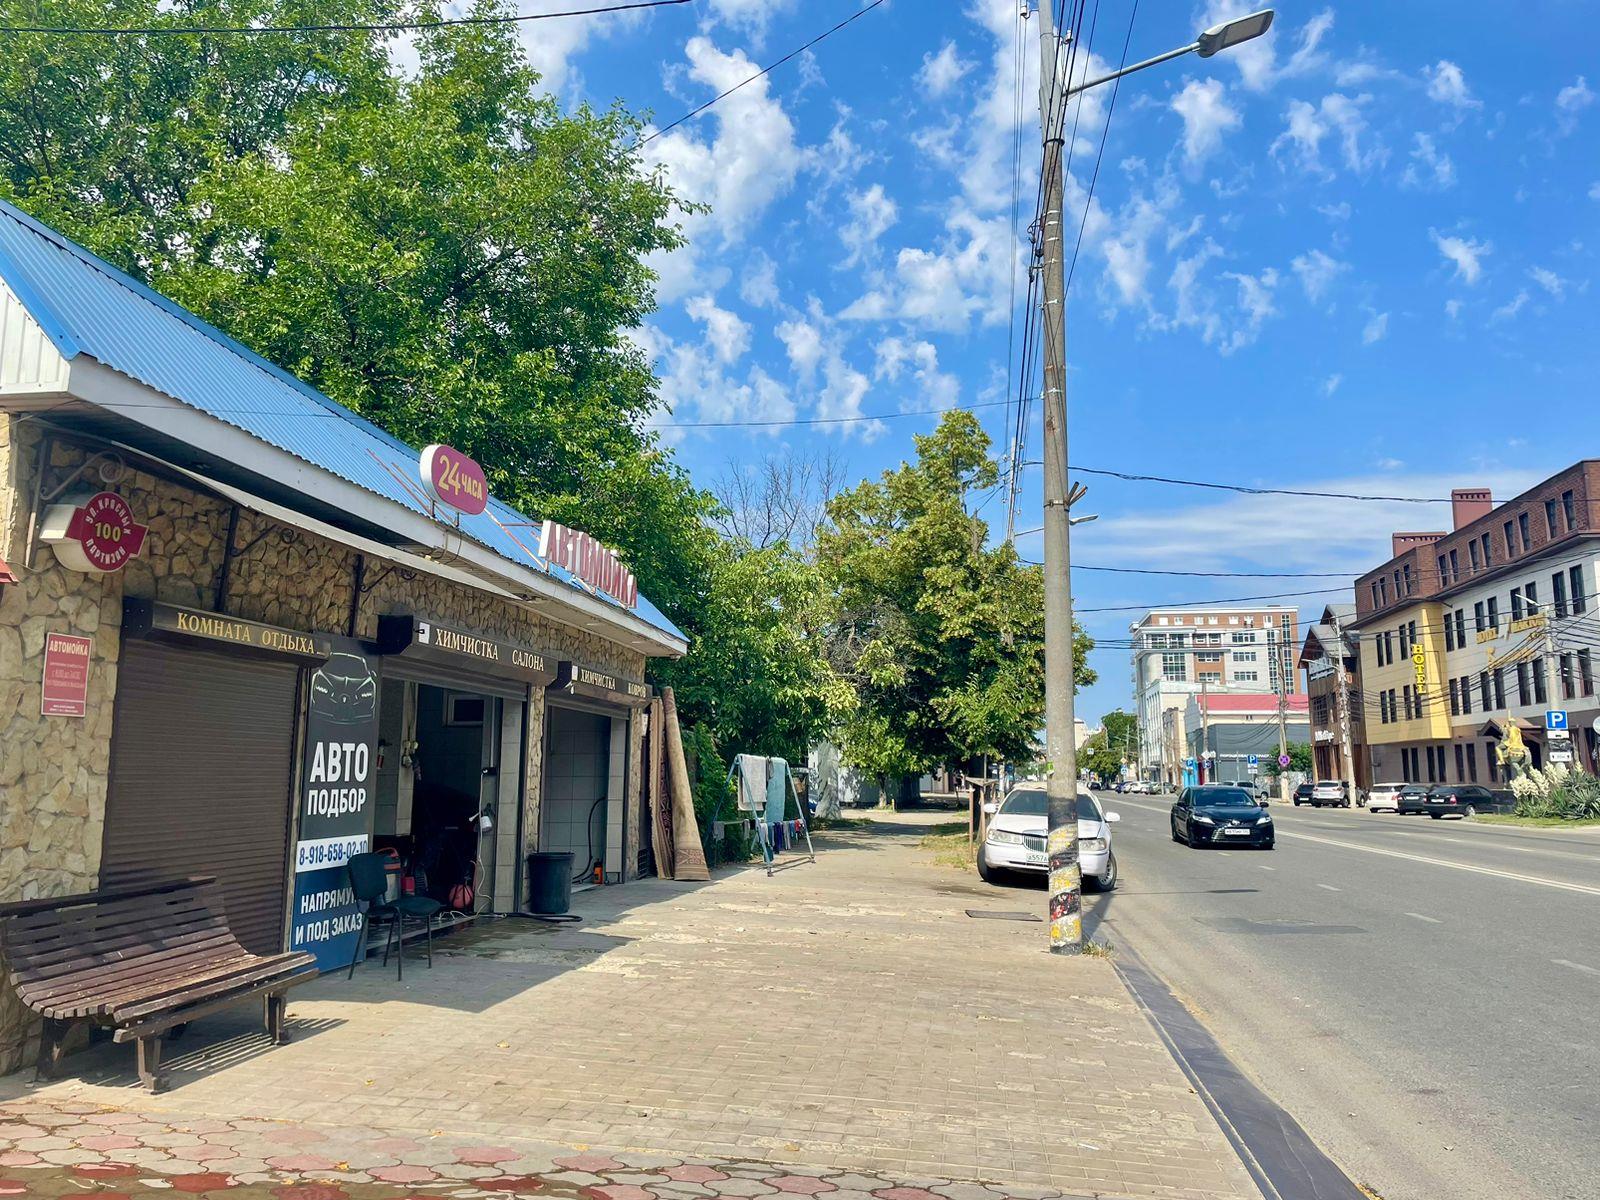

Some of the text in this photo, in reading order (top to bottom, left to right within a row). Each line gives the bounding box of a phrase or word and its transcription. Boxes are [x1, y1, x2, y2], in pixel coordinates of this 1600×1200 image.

[438, 455, 483, 501] 24 ЧАСА
[94, 522, 121, 542] 100
[98, 498, 131, 535] КРАСНЫХ
[86, 538, 126, 564] ПАРТИЗАН
[49, 640, 88, 656] АВТОМОЙКА
[177, 612, 314, 654] КОМНАТА ОТДЫХА
[435, 628, 544, 672] ХИМЧИСТКА САЛОНА
[580, 669, 647, 698] ХИМЧИСТКА КОВРОВ
[1412, 644, 1427, 694] HOTEL
[1551, 712, 1563, 727] P
[310, 742, 368, 782] АВТО
[308, 789, 366, 817] ПОДБОР
[301, 887, 357, 914] НАПРЯМУ
[295, 912, 363, 945] И ПОД ЗАКАЗ
